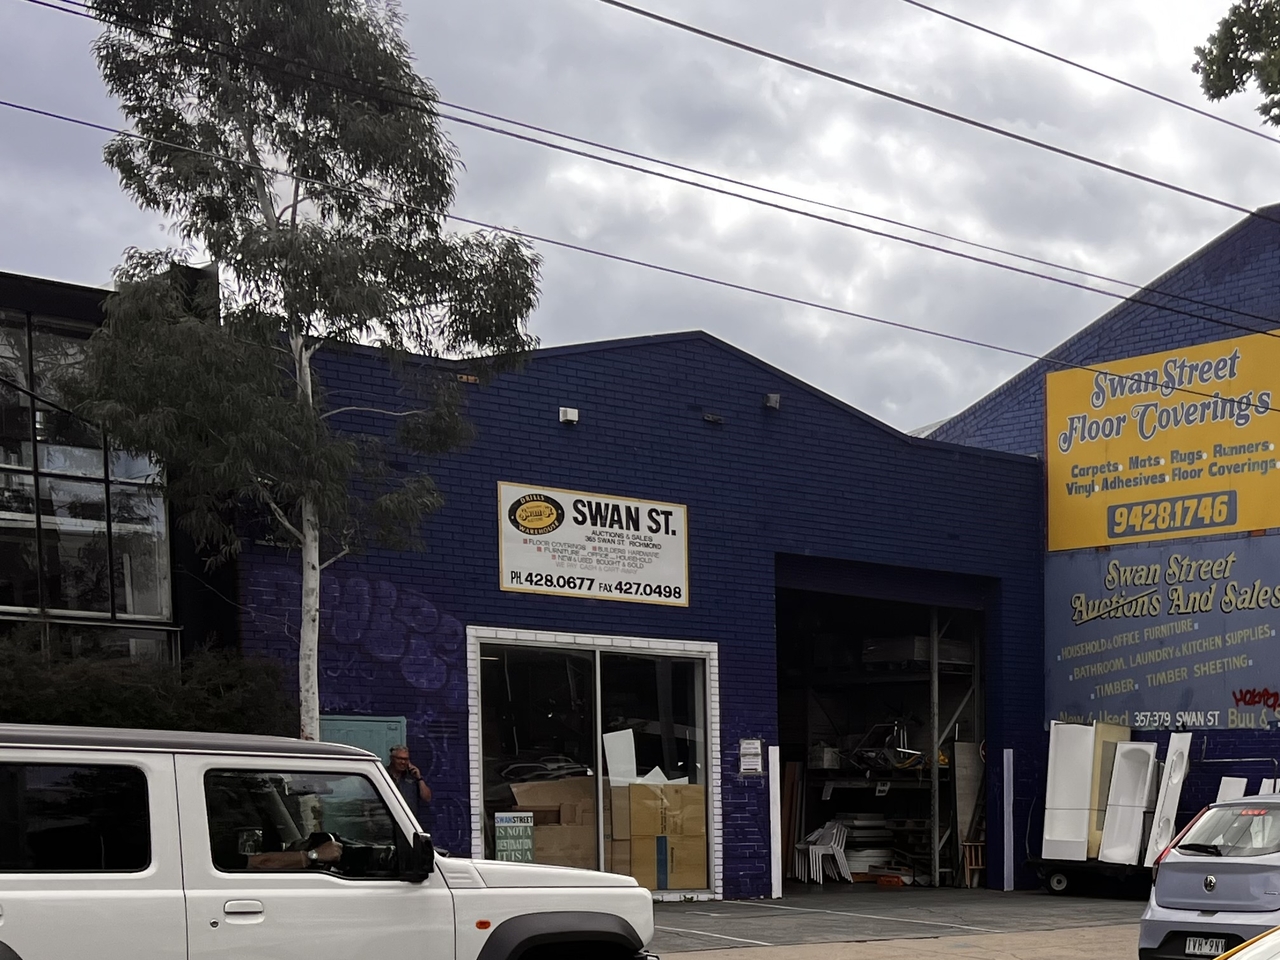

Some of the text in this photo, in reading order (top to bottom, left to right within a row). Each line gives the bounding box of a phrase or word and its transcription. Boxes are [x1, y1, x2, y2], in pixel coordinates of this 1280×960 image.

[1091, 348, 1241, 409] Swan Street
[1058, 391, 1271, 454] Floor Coverings
[1172, 466, 1203, 481] Floor
[520, 494, 545, 504] DRILLS
[572, 499, 676, 536] SWAN ST.
[518, 521, 559, 534] WAREHOUSE
[592, 530, 624, 539] AUCTIONS
[544, 547, 580, 556] FURNITURE
[551, 541, 586, 550] COVERINGS
[598, 546, 660, 558] BUILDERS HARDWARE
[629, 542, 662, 550] RICHMOND
[578, 556, 593, 564] USED
[1104, 551, 1237, 590] Swan Street
[525, 572, 595, 591] 428.0677
[599, 582, 612, 593] FAX
[615, 581, 681, 598] 427.0498
[1071, 587, 1162, 626] Auctions
[1168, 583, 1217, 616] And
[1144, 618, 1193, 642] FURNITURE
[1095, 654, 1247, 698] TIMBER TIMBER SHEETING
[1134, 712, 1171, 726] 357-379
[1176, 711, 1204, 726] SWAN
[496, 826, 532, 836] IS NOT A
[498, 851, 532, 861] IT IS A
